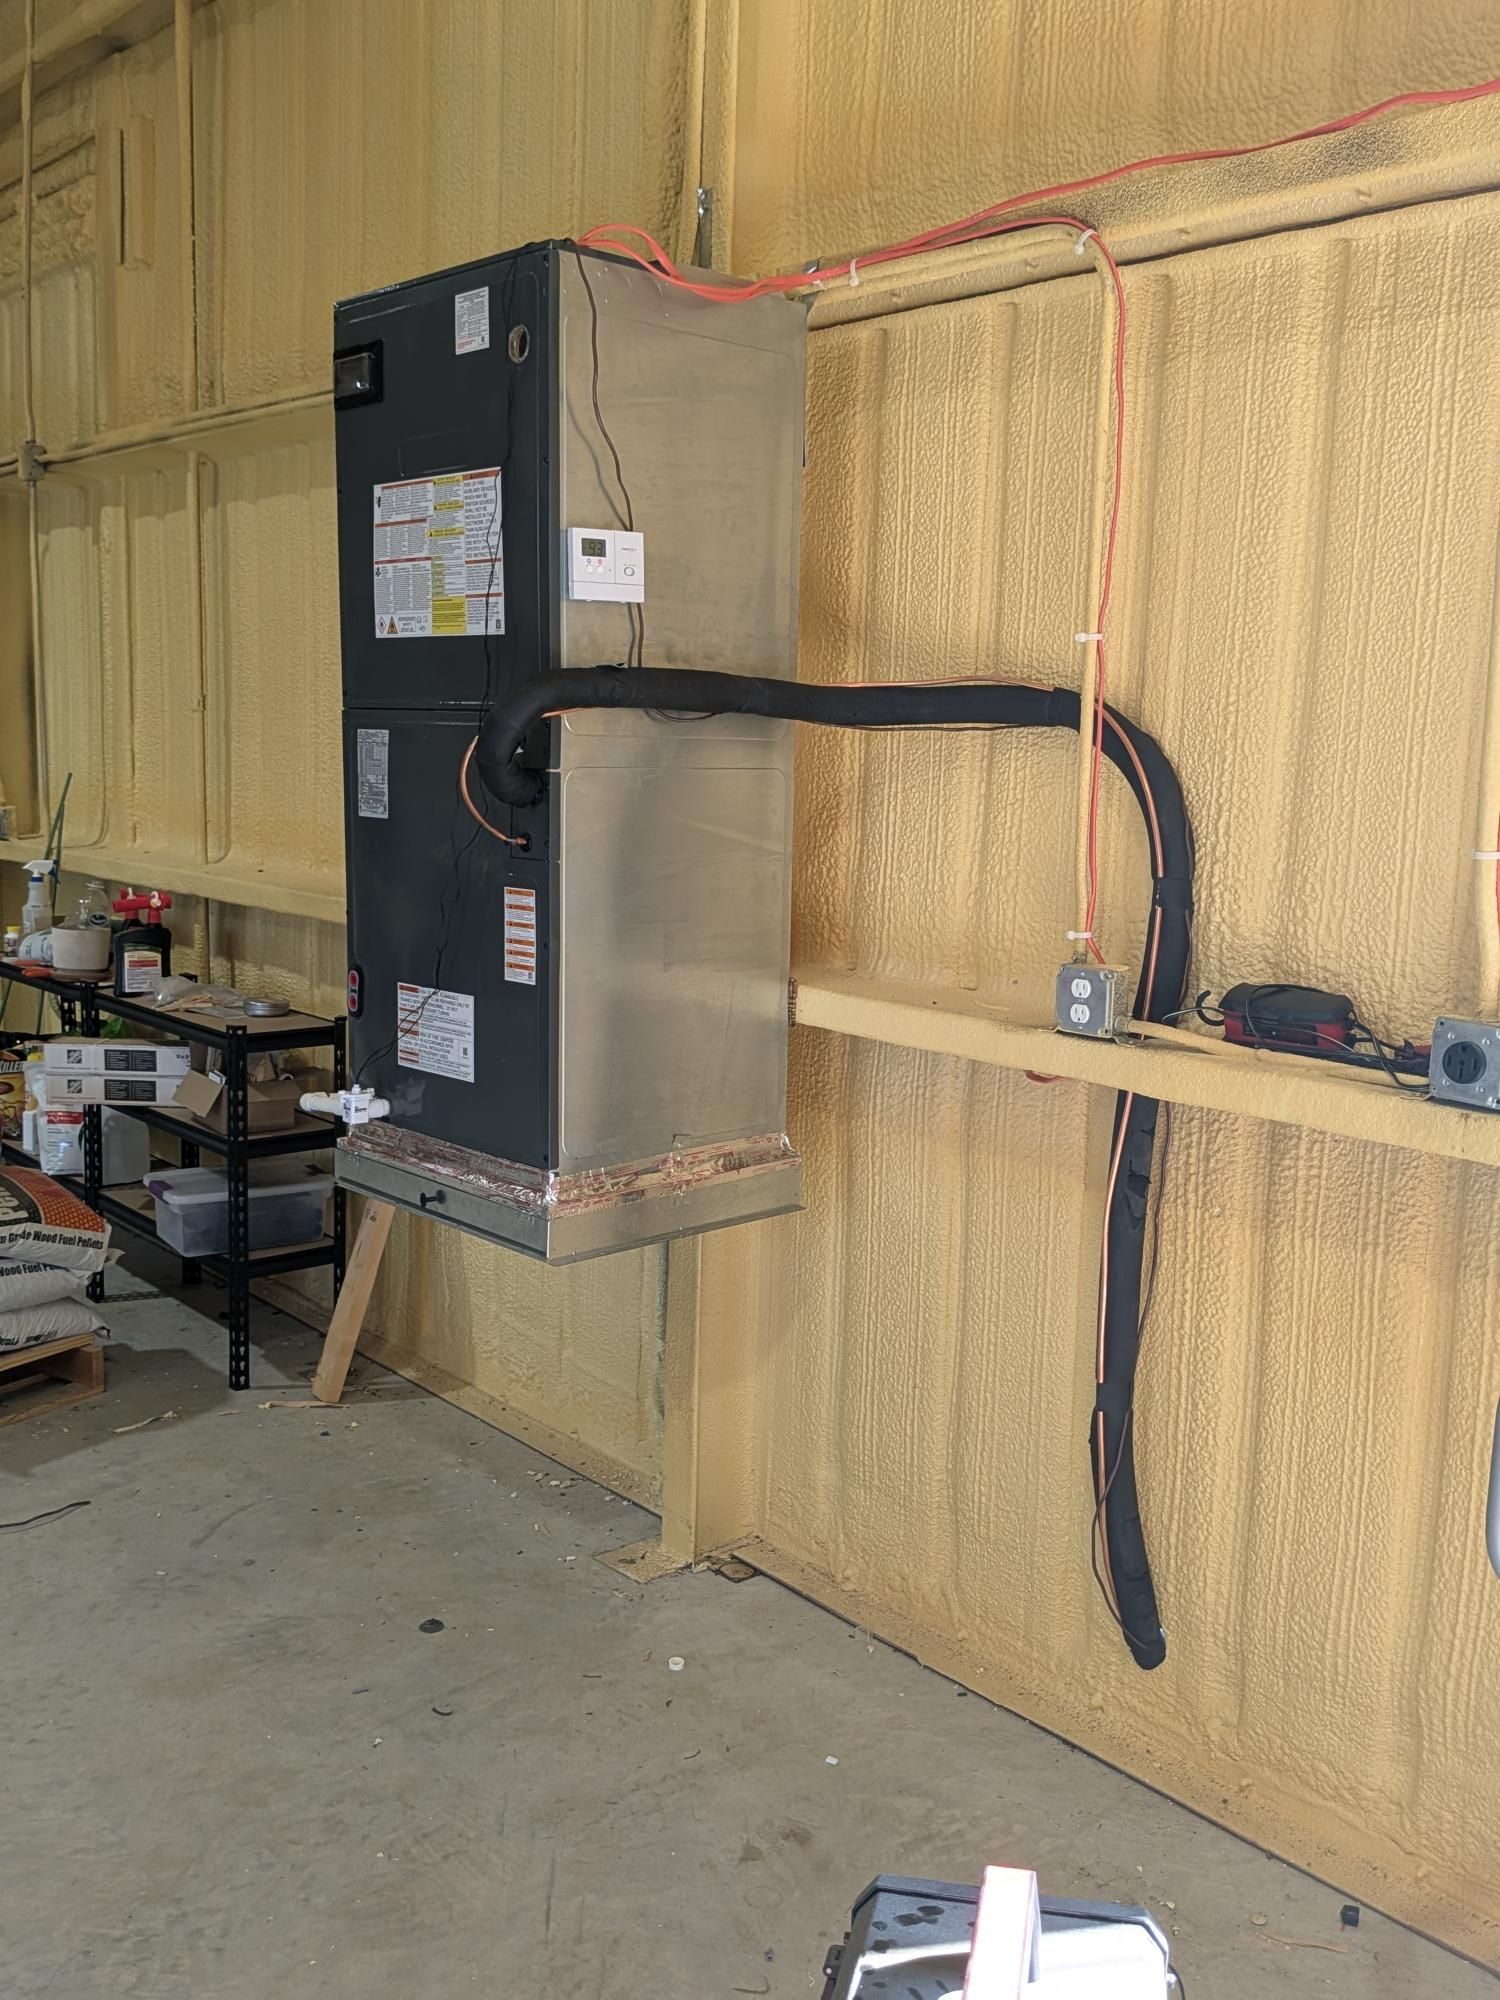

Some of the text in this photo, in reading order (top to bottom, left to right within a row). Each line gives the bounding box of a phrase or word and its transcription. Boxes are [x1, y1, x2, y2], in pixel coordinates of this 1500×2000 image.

[33, 1230, 58, 1244] Wood
[58, 1234, 76, 1246] Fuel
[77, 1236, 104, 1250] Pellets
[23, 1262, 42, 1274] Fuel
